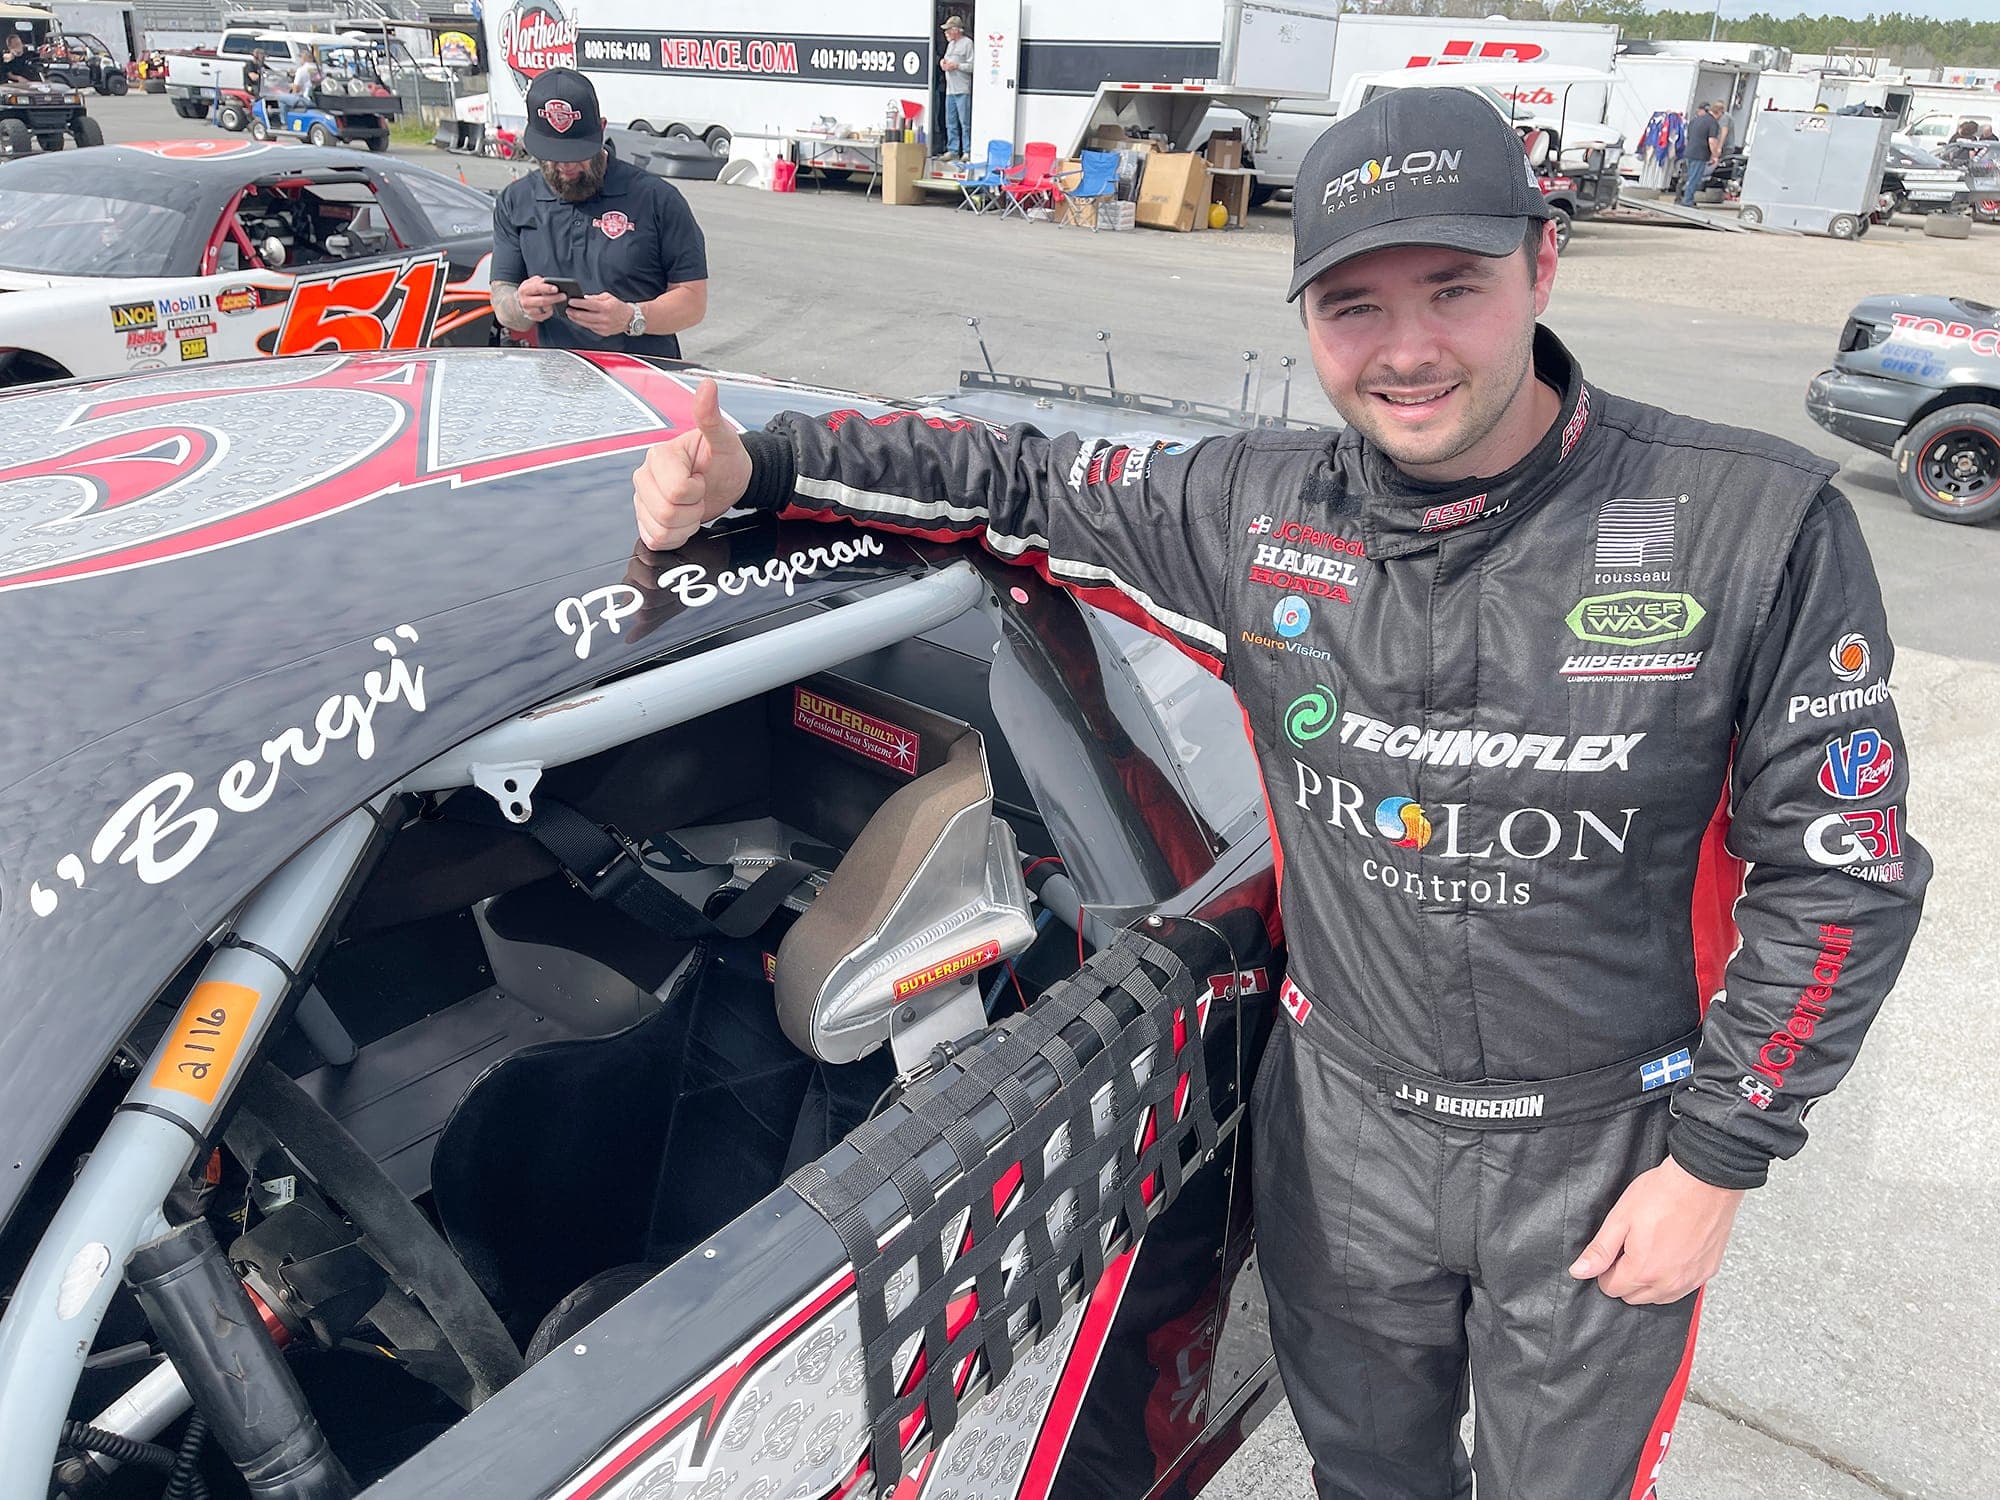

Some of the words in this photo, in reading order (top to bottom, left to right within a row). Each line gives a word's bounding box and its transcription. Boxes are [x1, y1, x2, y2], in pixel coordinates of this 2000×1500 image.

[499, 7, 578, 60] Northeast
[517, 52, 545, 69] RACE
[546, 51, 575, 68] CARS
[584, 40, 650, 61] 800-766-4748
[660, 38, 799, 73] NERACE.COM
[810, 48, 895, 71] 401-710-9992
[1321, 149, 1463, 205] PROLON
[1327, 181, 1396, 215] RACING
[1410, 174, 1460, 186] TEAM
[158, 295, 196, 314] Mobil
[275, 253, 448, 355] 51
[127, 330, 167, 348] Holley
[169, 315, 209, 330] LINCOLN
[1890, 312, 2000, 356] TOPC
[1422, 493, 1488, 527] FESTI
[1253, 543, 1359, 587] HAMEL
[1594, 570, 1671, 585] rousseau
[554, 584, 644, 659] JP
[657, 534, 884, 608] Bergeron
[1248, 566, 1352, 603] HONDA
[1586, 601, 1683, 617] SILVER
[1586, 614, 1683, 633] WAX
[1241, 631, 1331, 662] NeuroVision
[1559, 651, 1703, 673] HIPERTECH
[798, 712, 843, 738] Professional
[844, 730, 861, 745] Seat
[862, 738, 892, 759] Systems
[1339, 711, 1648, 772] TECHNOFLEX
[1825, 728, 1882, 800] VP
[1859, 758, 1894, 788] Racing
[1292, 757, 1642, 861] PROLON
[1362, 858, 1531, 905] controls
[1396, 1083, 1429, 1106] J-P
[1435, 1094, 1545, 1118] BERGERON
